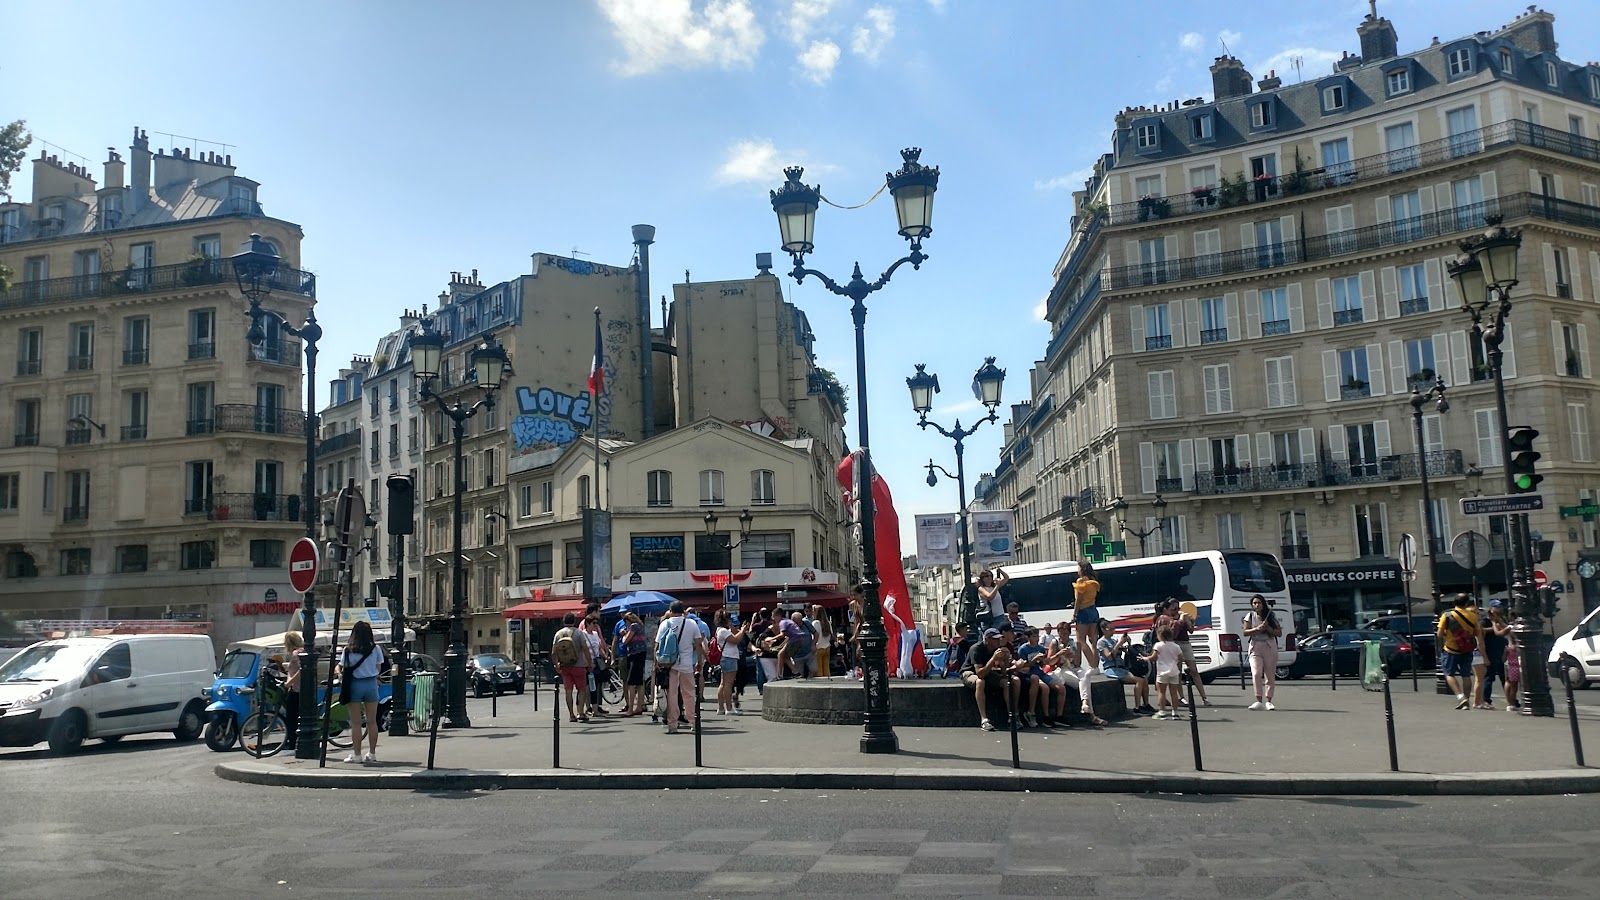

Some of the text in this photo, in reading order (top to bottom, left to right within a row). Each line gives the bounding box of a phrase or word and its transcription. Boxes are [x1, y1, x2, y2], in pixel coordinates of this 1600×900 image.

[1286, 570, 1396, 583] ARBUCKS COFFEE
[729, 588, 736, 599] P
